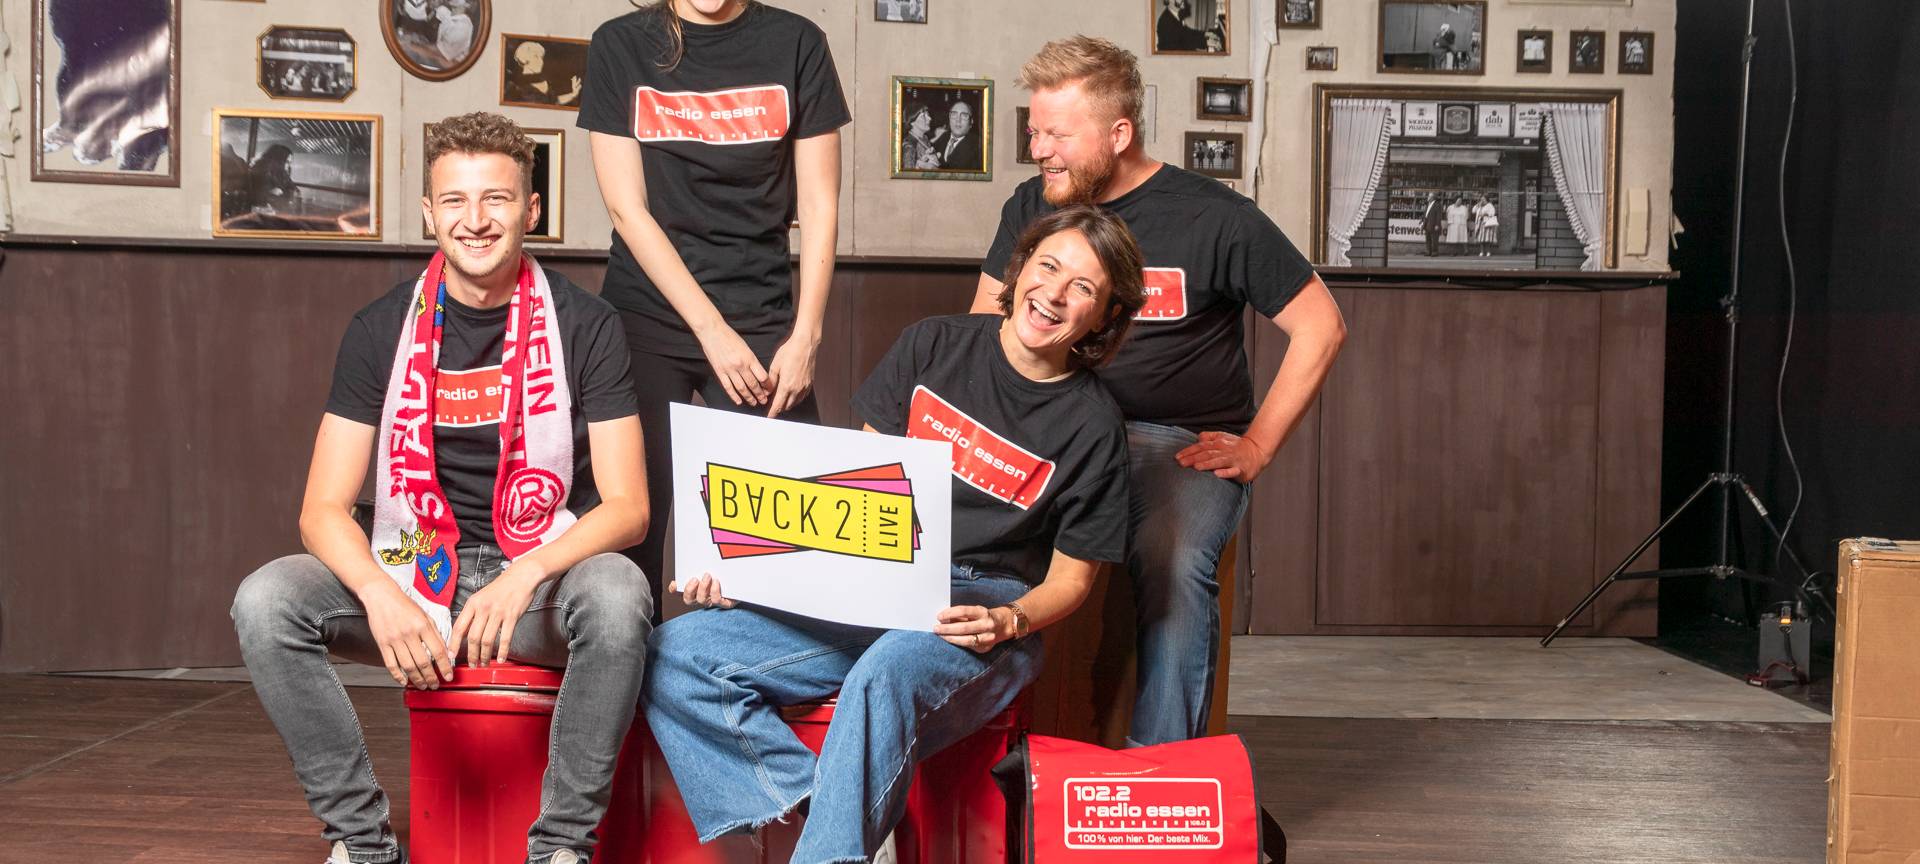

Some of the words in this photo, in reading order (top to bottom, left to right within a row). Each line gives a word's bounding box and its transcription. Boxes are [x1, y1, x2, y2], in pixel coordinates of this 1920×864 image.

[655, 105, 703, 120] radio
[710, 105, 767, 120] essen
[436, 387, 478, 401] radio
[922, 413, 971, 449] radio
[974, 447, 1027, 481] essen
[721, 479, 819, 536] BACK
[835, 500, 851, 541] 2
[879, 504, 899, 548] LIVE
[1073, 785, 1131, 801] 102.2
[1085, 803, 1142, 817] radio
[1146, 805, 1210, 817] essen
[1108, 835, 1123, 843] von
[1126, 834, 1144, 843] hier.
[1147, 834, 1164, 843] Der
[1166, 834, 1190, 843] beste
[1193, 834, 1211, 843] Mix.
